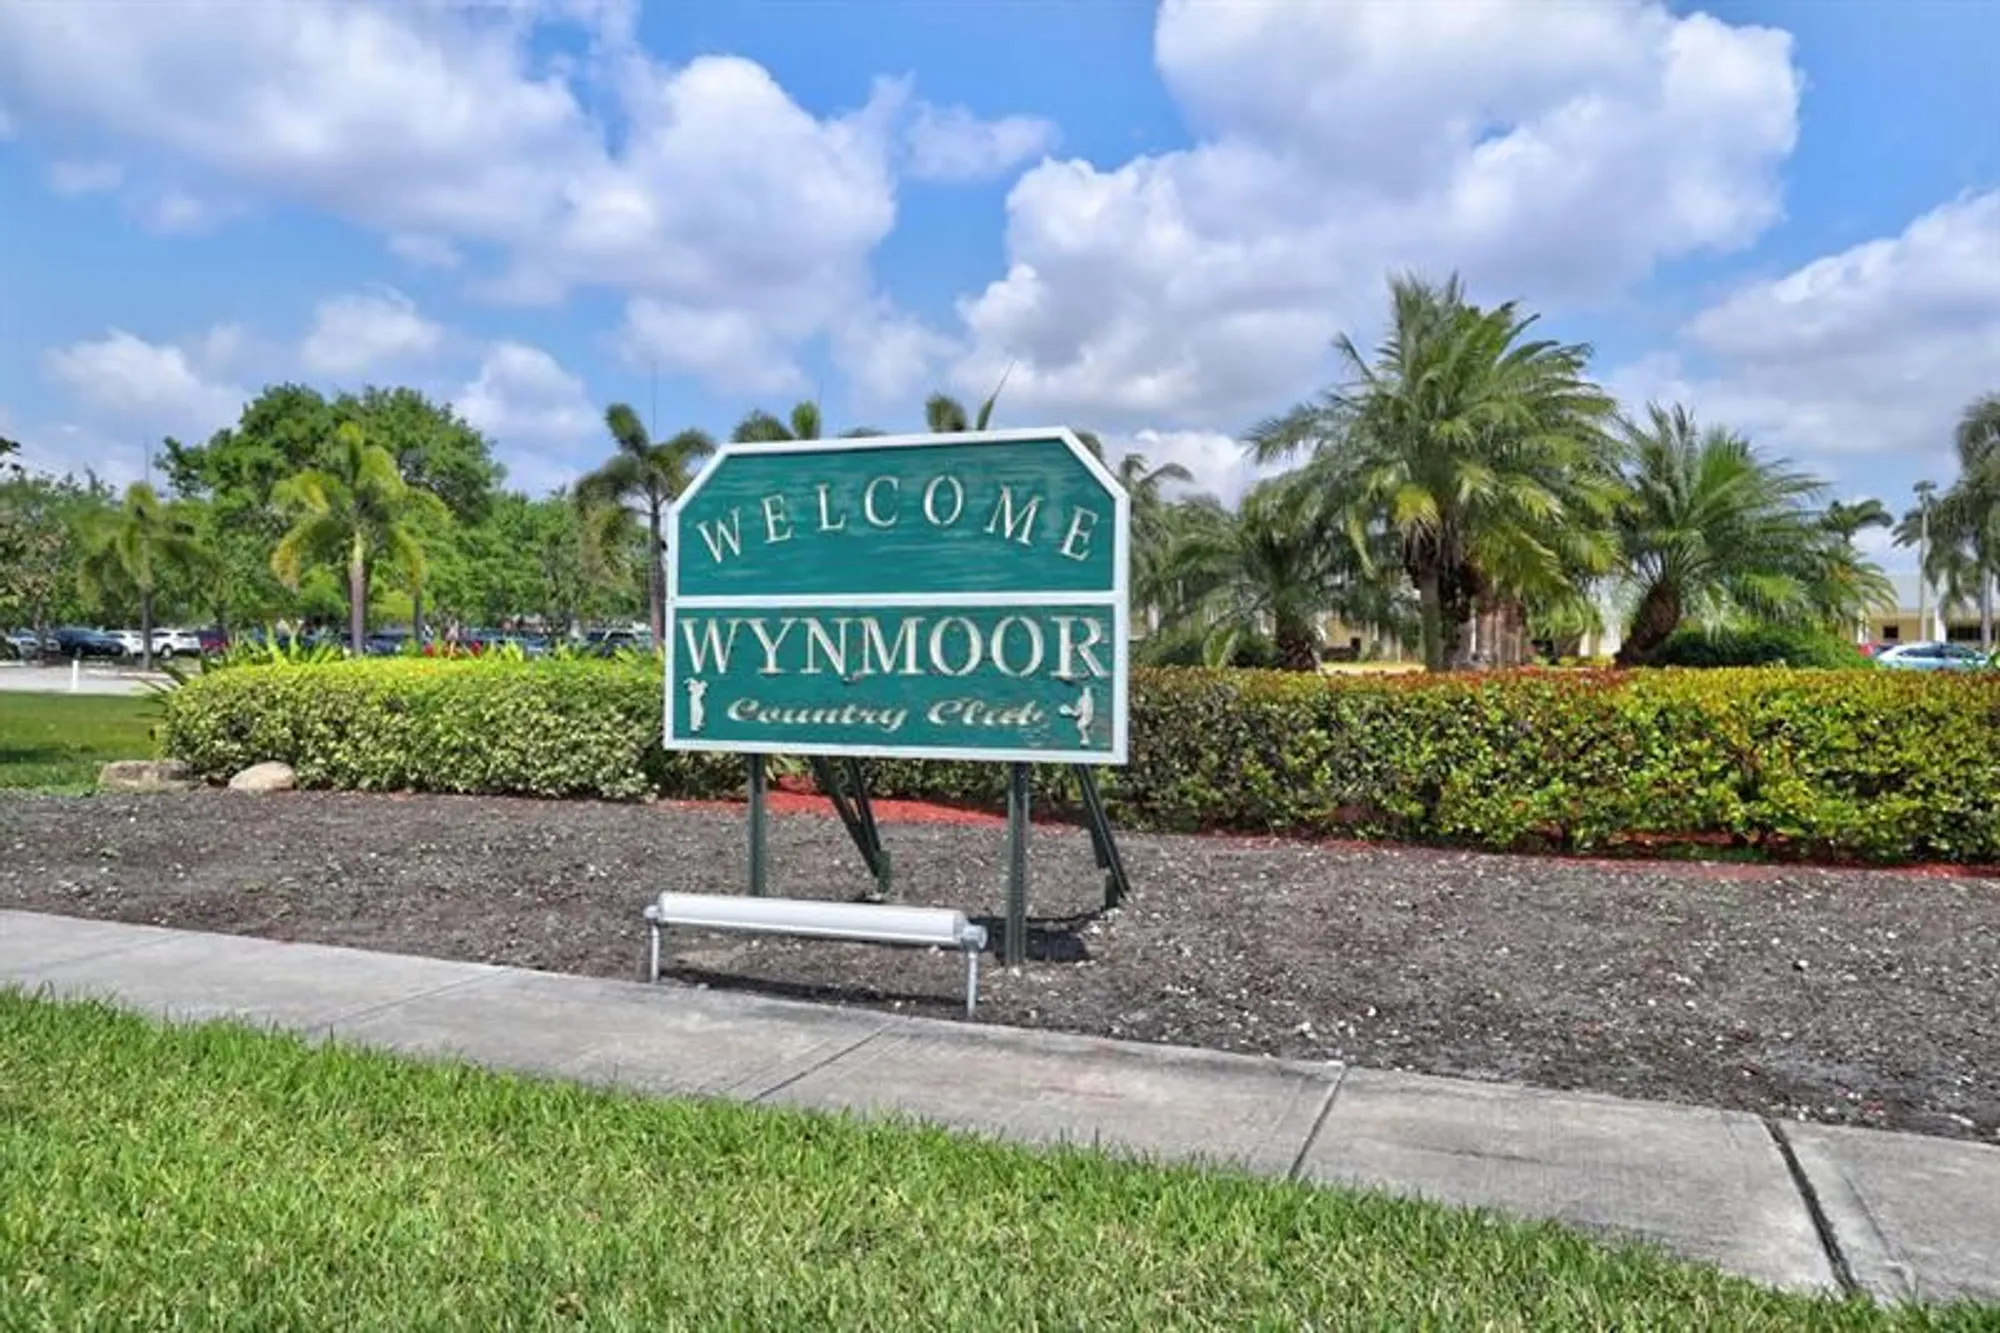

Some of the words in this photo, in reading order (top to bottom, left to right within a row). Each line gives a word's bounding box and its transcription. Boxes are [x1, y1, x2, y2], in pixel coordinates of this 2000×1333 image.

[696, 474, 1098, 563] WELCOME
[680, 615, 1110, 679] WYNMOOR
[726, 697, 908, 731] Country
[926, 697, 1048, 728] Club
